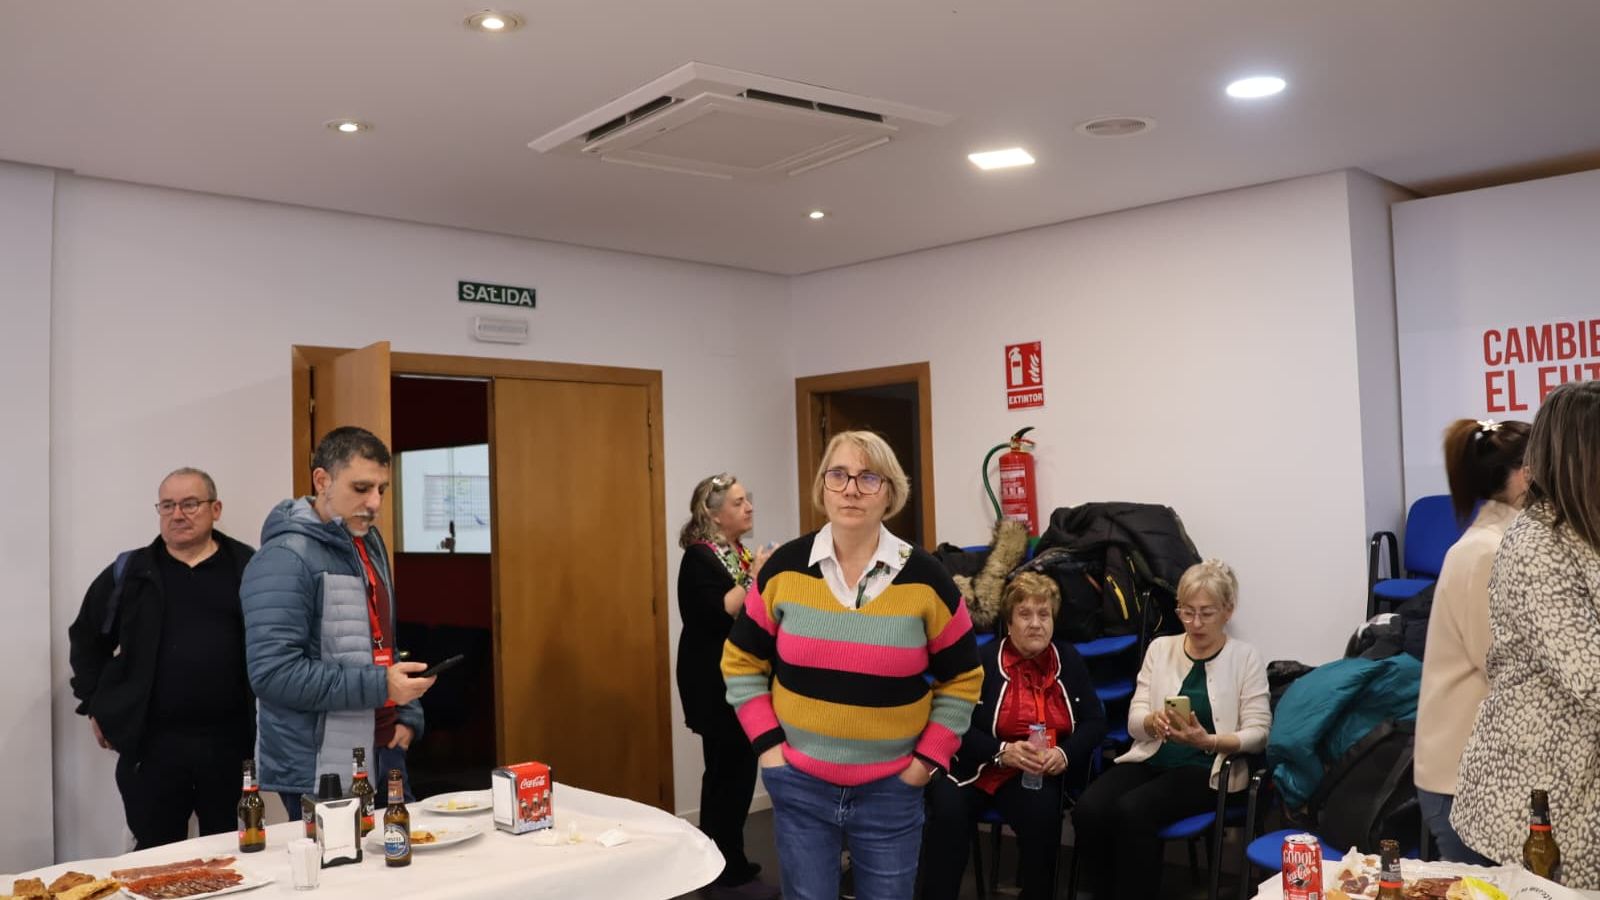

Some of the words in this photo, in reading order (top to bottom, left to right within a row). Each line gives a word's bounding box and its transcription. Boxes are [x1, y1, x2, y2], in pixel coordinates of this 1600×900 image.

[462, 284, 533, 306] SALIDA
[1008, 393, 1043, 405] EXTINTOR
[1485, 370, 1528, 412] EL
